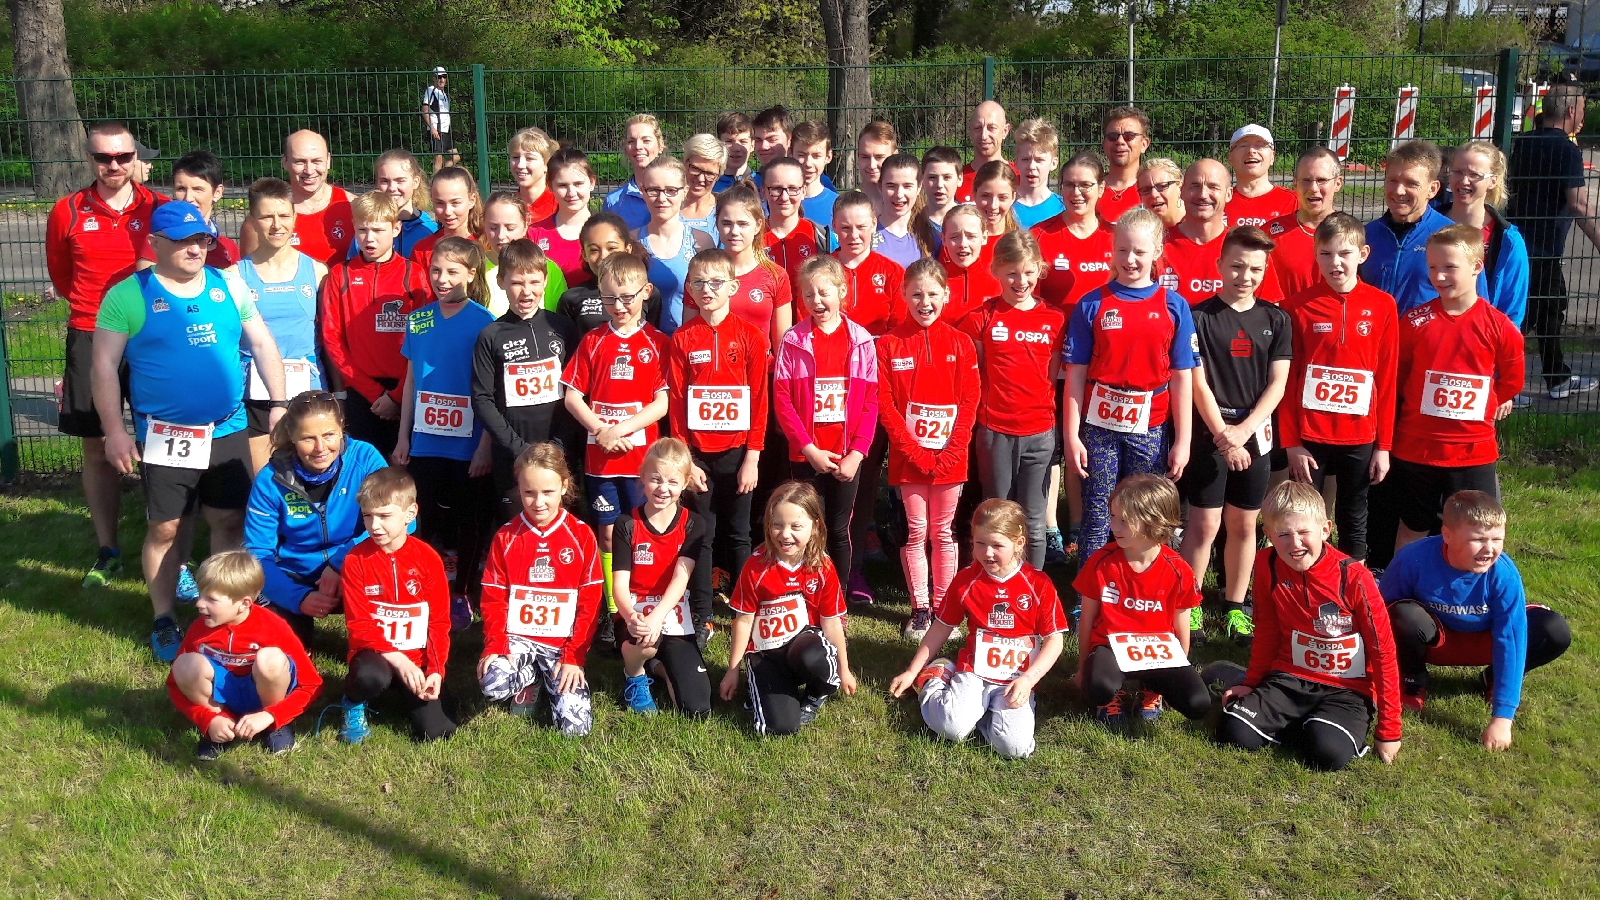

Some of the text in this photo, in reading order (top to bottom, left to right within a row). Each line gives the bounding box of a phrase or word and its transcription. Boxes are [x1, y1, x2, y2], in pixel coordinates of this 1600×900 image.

[1236, 217, 1267, 227] OSPA
[1079, 262, 1110, 272] OSPA
[1190, 278, 1224, 292] OSP
[186, 304, 200, 314] AS
[187, 331, 218, 347] sport
[1014, 331, 1050, 344] OSPA
[503, 347, 530, 361] sport
[1331, 373, 1354, 383] OSPA
[1448, 379, 1472, 388] OSPA
[515, 374, 555, 397] 634
[821, 382, 844, 391] OSPA
[711, 391, 731, 400] OSPA
[1112, 394, 1134, 404] OSPA
[1314, 382, 1358, 404] 625
[1433, 387, 1477, 410] 632
[437, 397, 457, 407] OSPA
[814, 393, 845, 413] 647
[424, 406, 463, 428] 650
[606, 406, 627, 417] OSPA
[698, 402, 739, 420] 626
[929, 410, 948, 418] OSPA
[1097, 401, 1138, 425] 644
[172, 429, 194, 439] OSPA
[914, 418, 951, 439] 624
[164, 437, 192, 458] 13
[534, 594, 558, 603] OSPA
[1123, 597, 1163, 612] OSPA
[385, 609, 411, 619] OSPA
[519, 603, 561, 626] 631
[764, 605, 788, 615] OSPA
[758, 613, 798, 640] 620
[1126, 644, 1173, 662] 643
[1315, 641, 1344, 651] OSPA
[986, 647, 1030, 673] 649
[1303, 650, 1352, 671] 635
